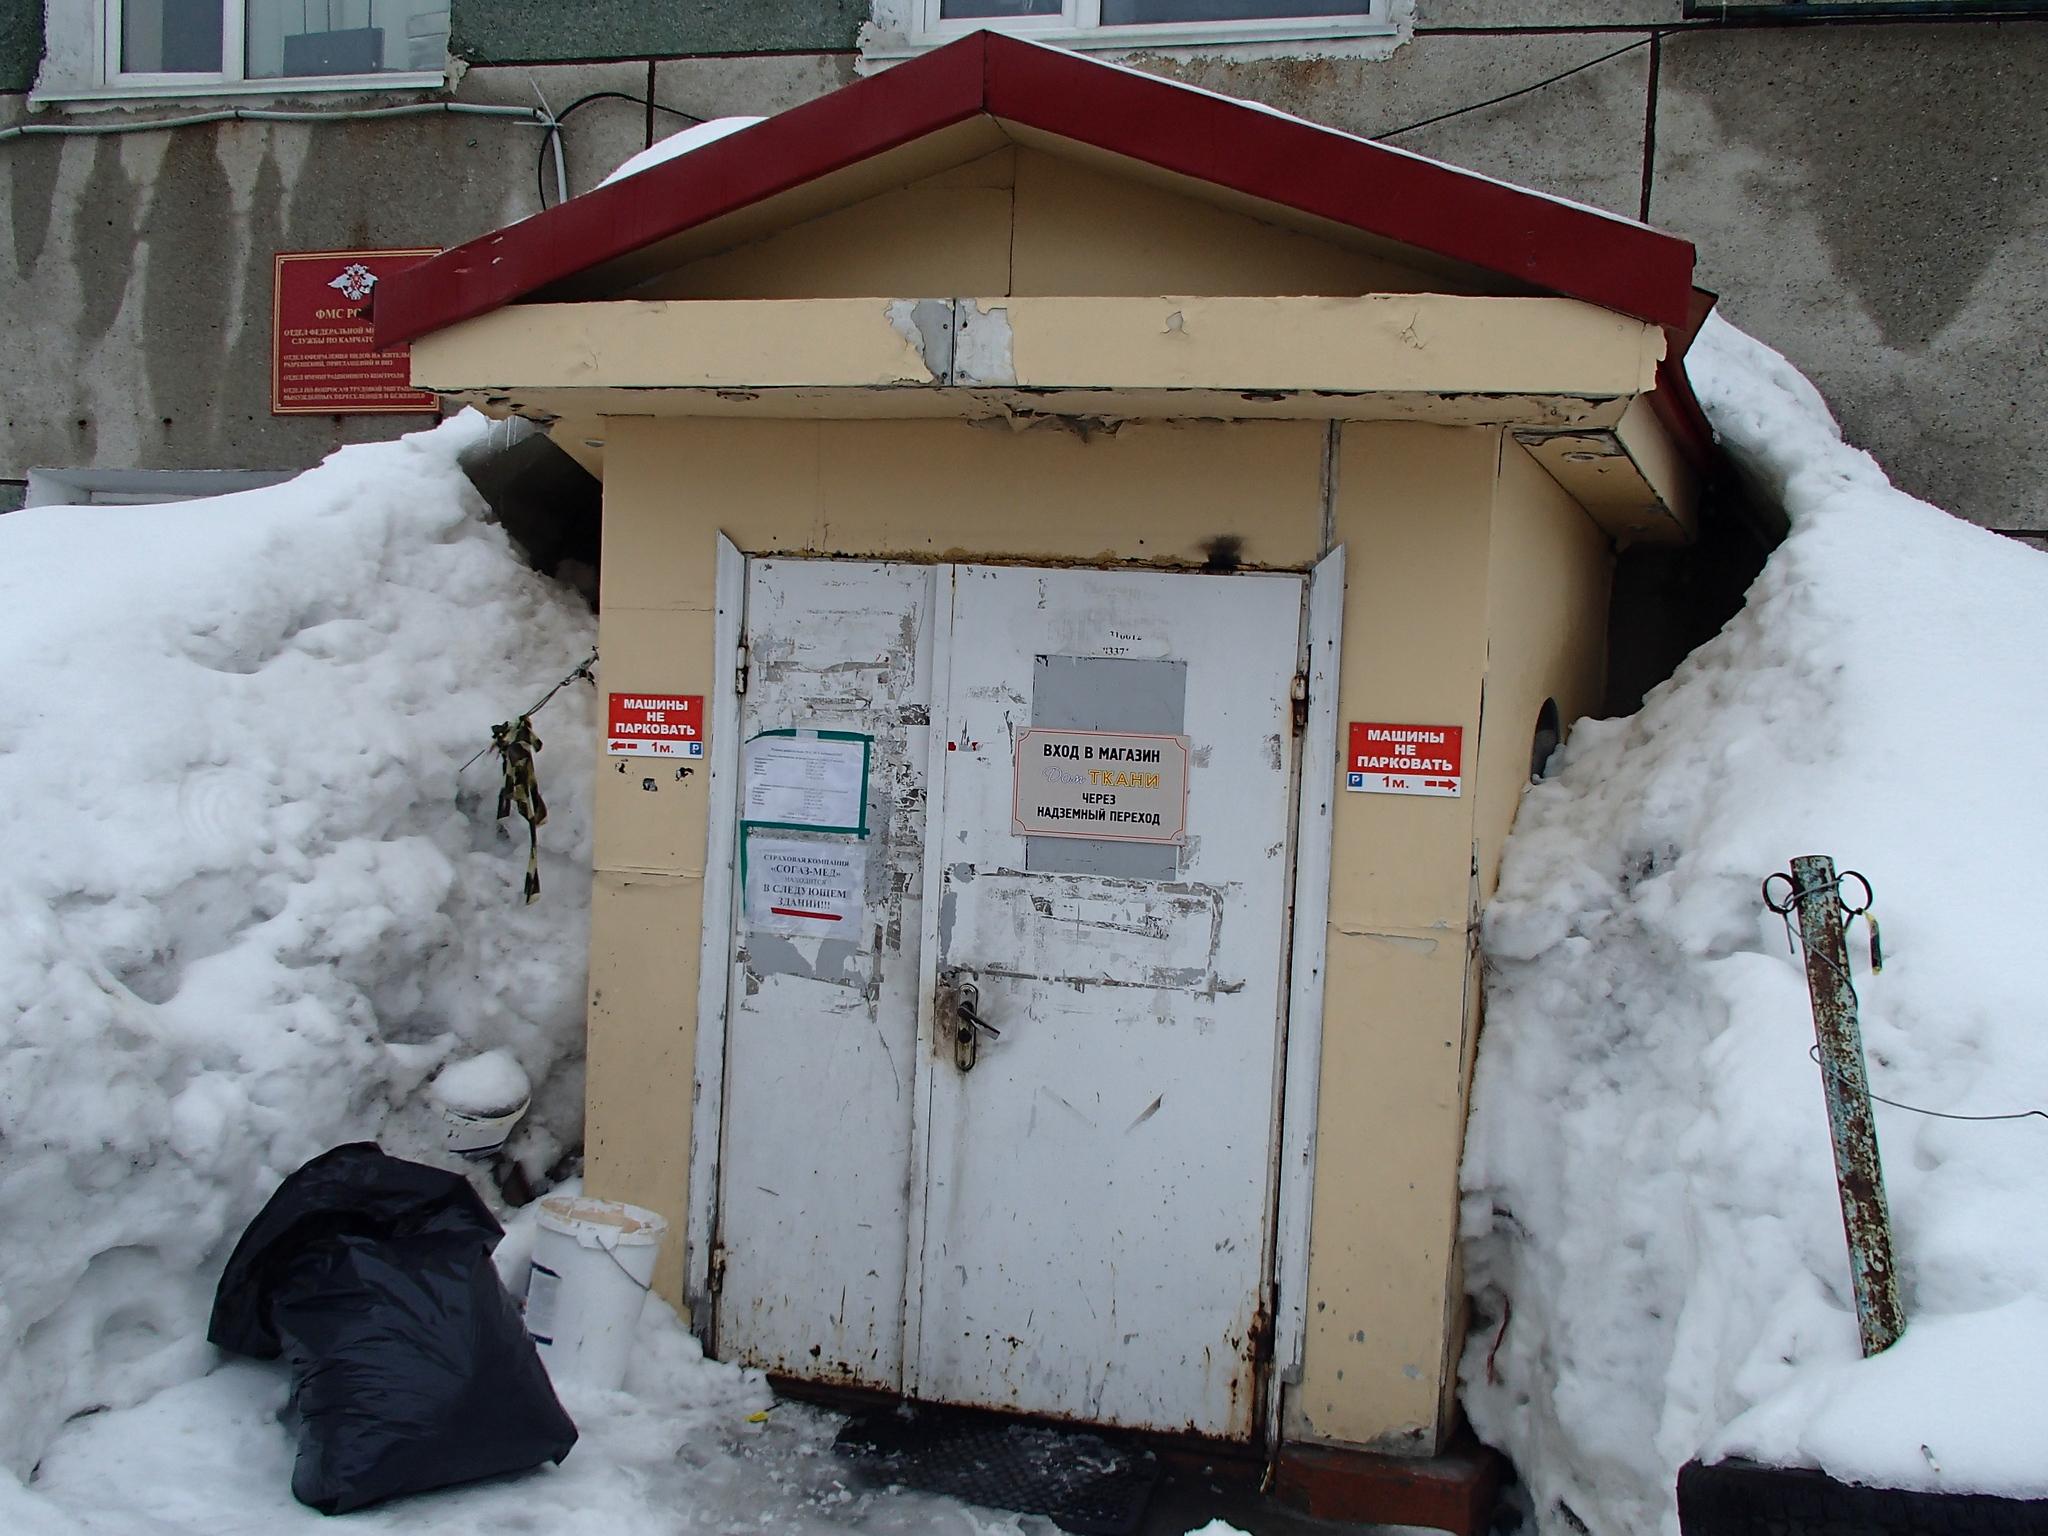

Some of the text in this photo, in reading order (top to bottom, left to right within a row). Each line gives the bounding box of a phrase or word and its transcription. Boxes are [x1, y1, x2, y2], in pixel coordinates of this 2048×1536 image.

[315, 308, 345, 319] ФМС
[309, 327, 364, 336] ФЕДЕРАЛЬНОЙ
[623, 698, 689, 711] МАШИНЫ
[646, 711, 666, 722] НЕ
[615, 722, 696, 735] ПАРКОВАТЬ
[1367, 729, 1445, 744] МАШИНЫ
[1043, 743, 1161, 763] ВХОД В МАГАЗИН
[1394, 744, 1417, 756] НЕ
[1357, 756, 1453, 771] ПАРКОВАТЬ
[1087, 768, 1160, 789] ТКАНИ
[1081, 792, 1116, 805] ЧЕРЕЗ
[1037, 806, 1161, 826] НАДЗЕМНЫЙ ПЕРЕХОД
[763, 854, 850, 867] СТРАХОВАЯ КОМПАНИЯ
[763, 884, 847, 899] В СЛЕДУЮЩЕМ
